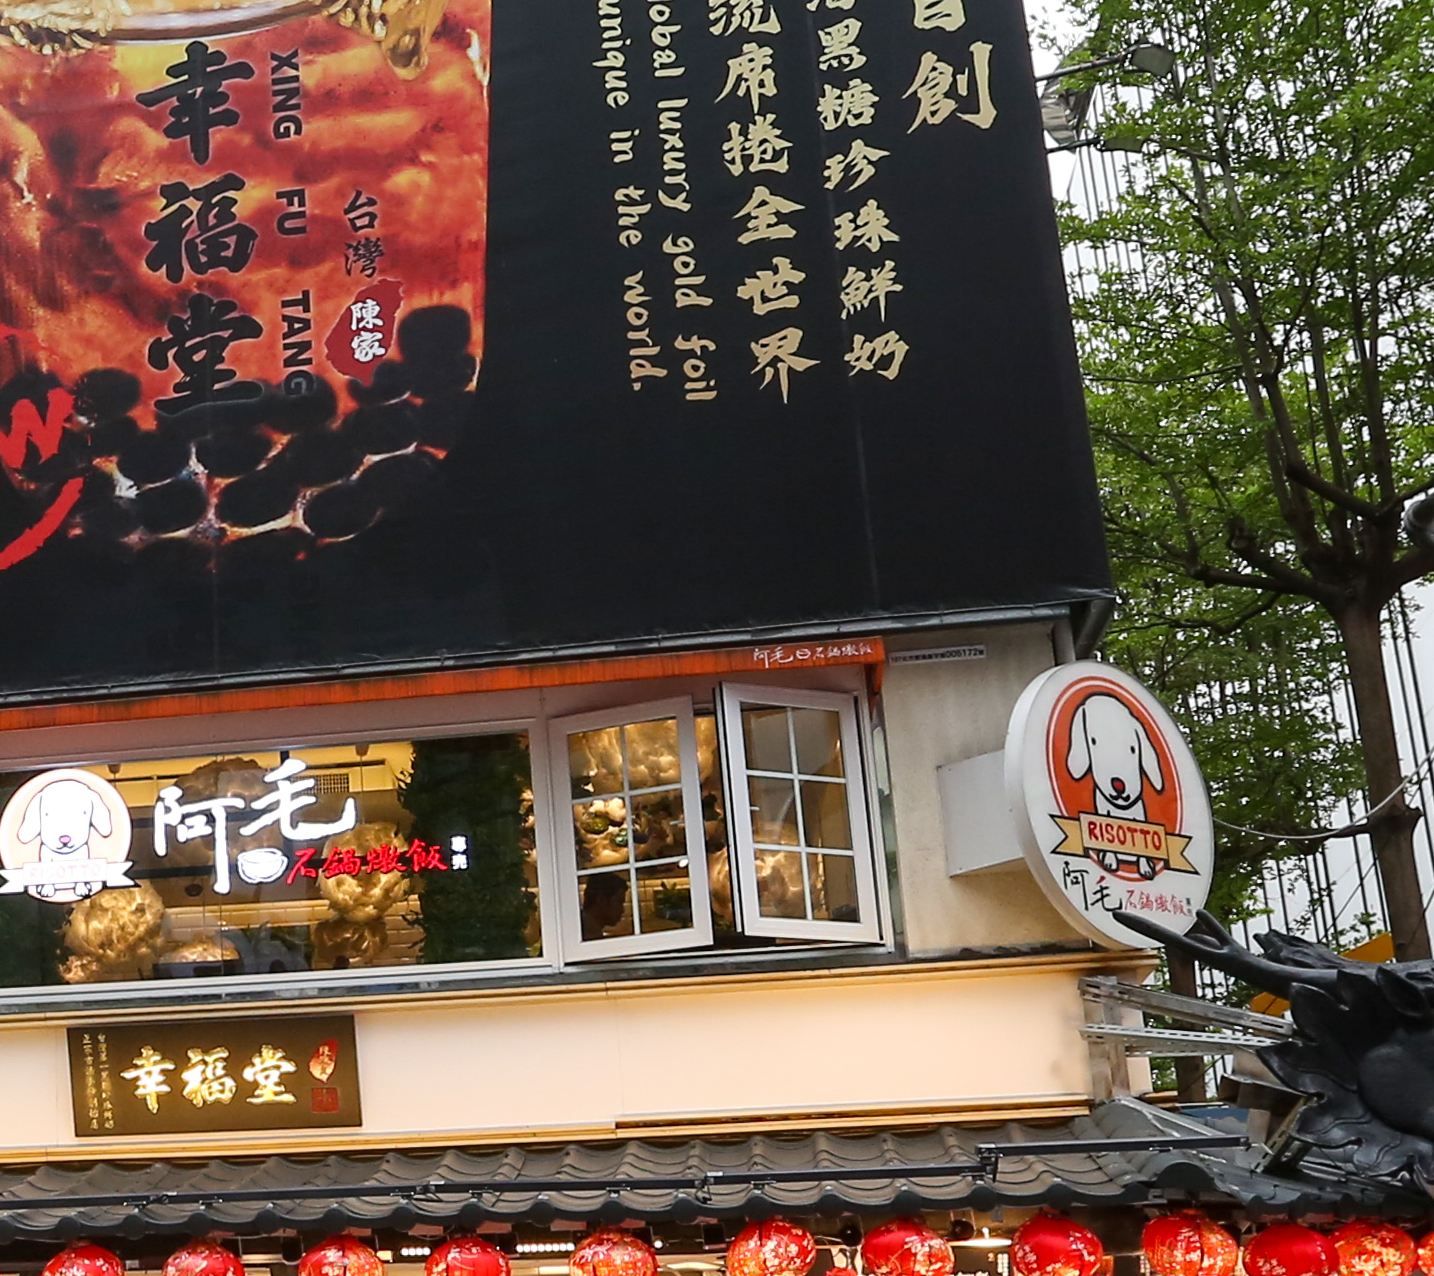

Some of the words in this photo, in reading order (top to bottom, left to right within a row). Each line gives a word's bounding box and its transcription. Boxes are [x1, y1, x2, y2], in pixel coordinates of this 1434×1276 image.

[269, 48, 302, 140] XING
[609, 129, 634, 163] in
[658, 99, 692, 211] luxury
[136, 41, 265, 416] 幸福堂
[275, 188, 306, 237] FU
[342, 189, 385, 278] 台灣
[614, 185, 652, 248] the
[662, 234, 713, 308] gold
[280, 288, 316, 397] TANG
[350, 298, 385, 363] 陳家
[624, 270, 667, 391] world.
[674, 333, 717, 401] foil
[154, 759, 356, 895] 阿毛
[1088, 821, 1162, 851] RISOTTO
[1063, 861, 1123, 912] 阿毛
[120, 1045, 297, 1113] 幸福堂
